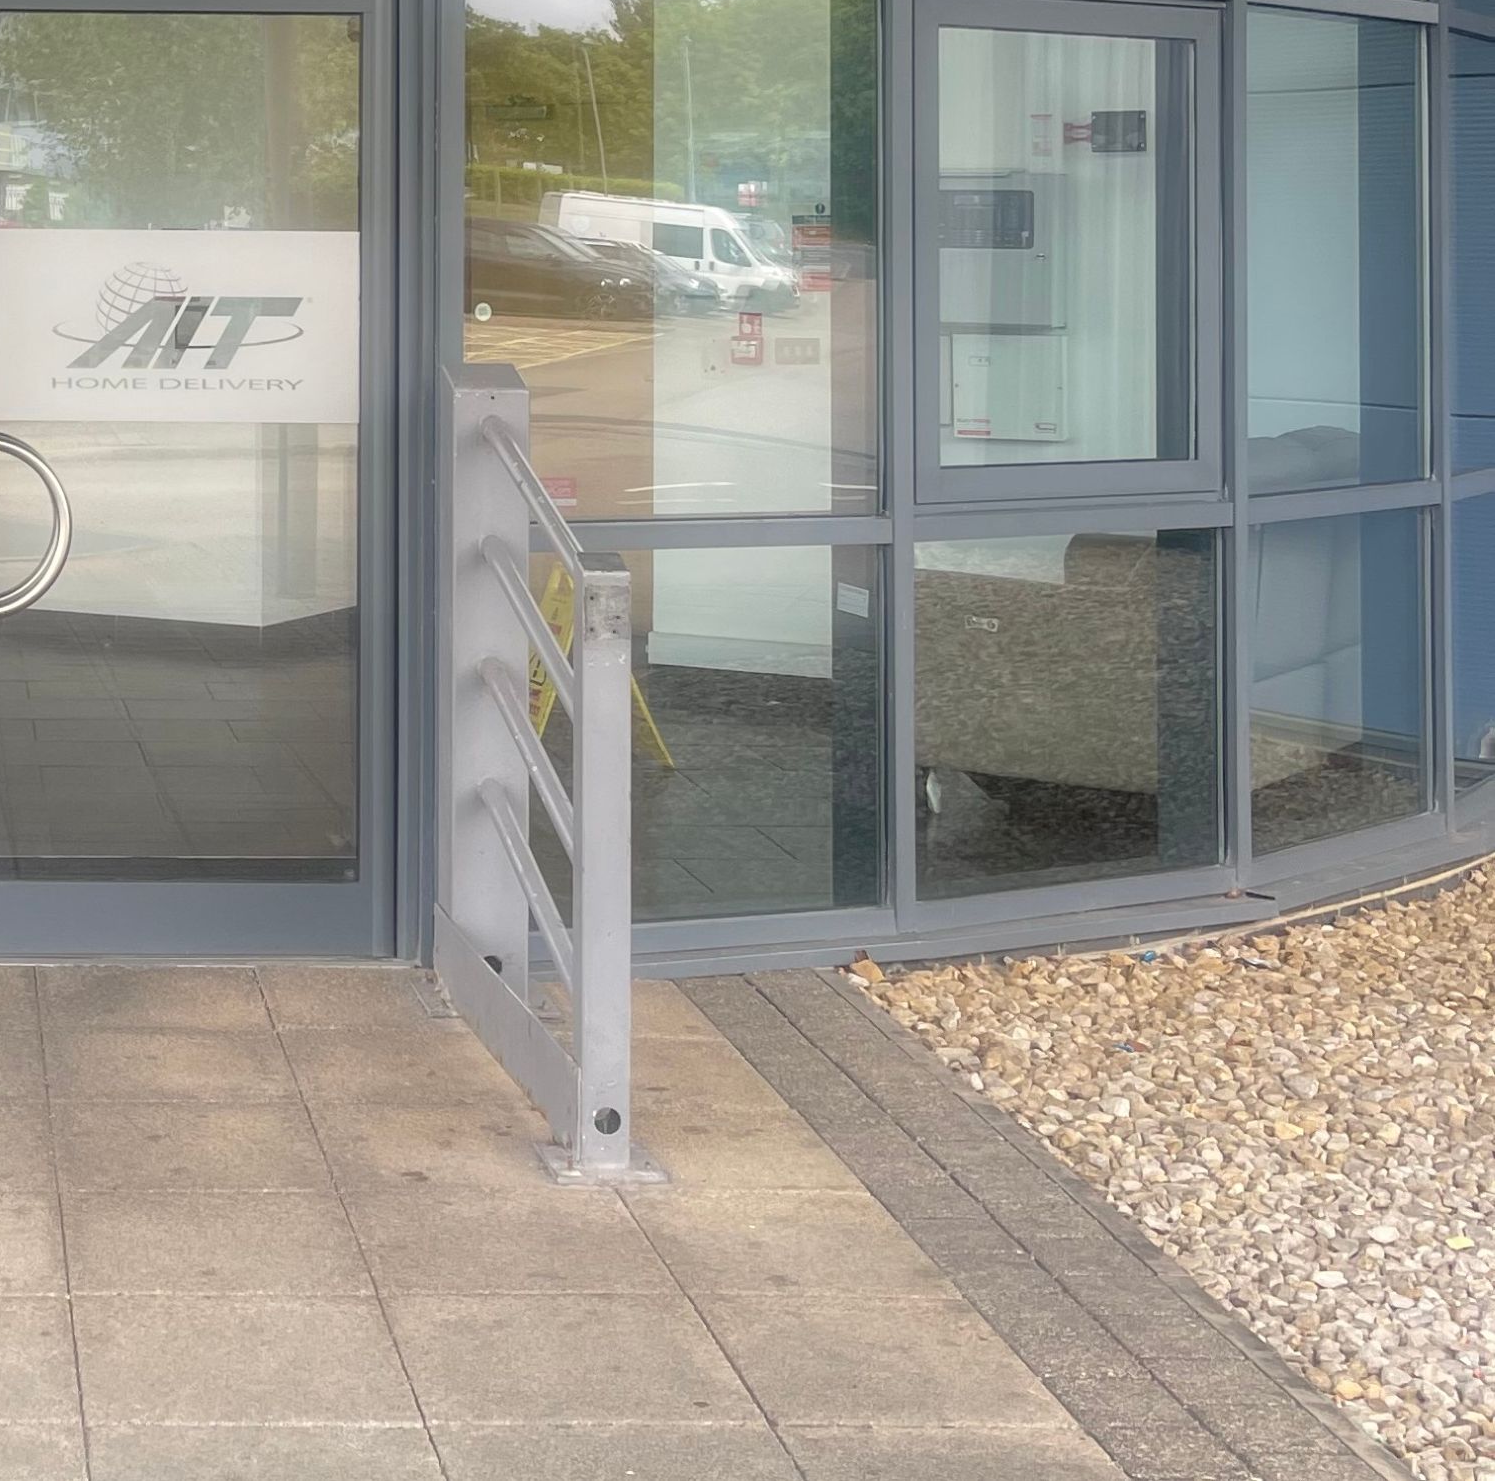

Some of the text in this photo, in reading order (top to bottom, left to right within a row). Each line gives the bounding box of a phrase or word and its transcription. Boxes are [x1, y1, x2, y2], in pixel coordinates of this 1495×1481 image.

[65, 296, 304, 369] AIT
[51, 376, 304, 391] HOME DELIVERY
